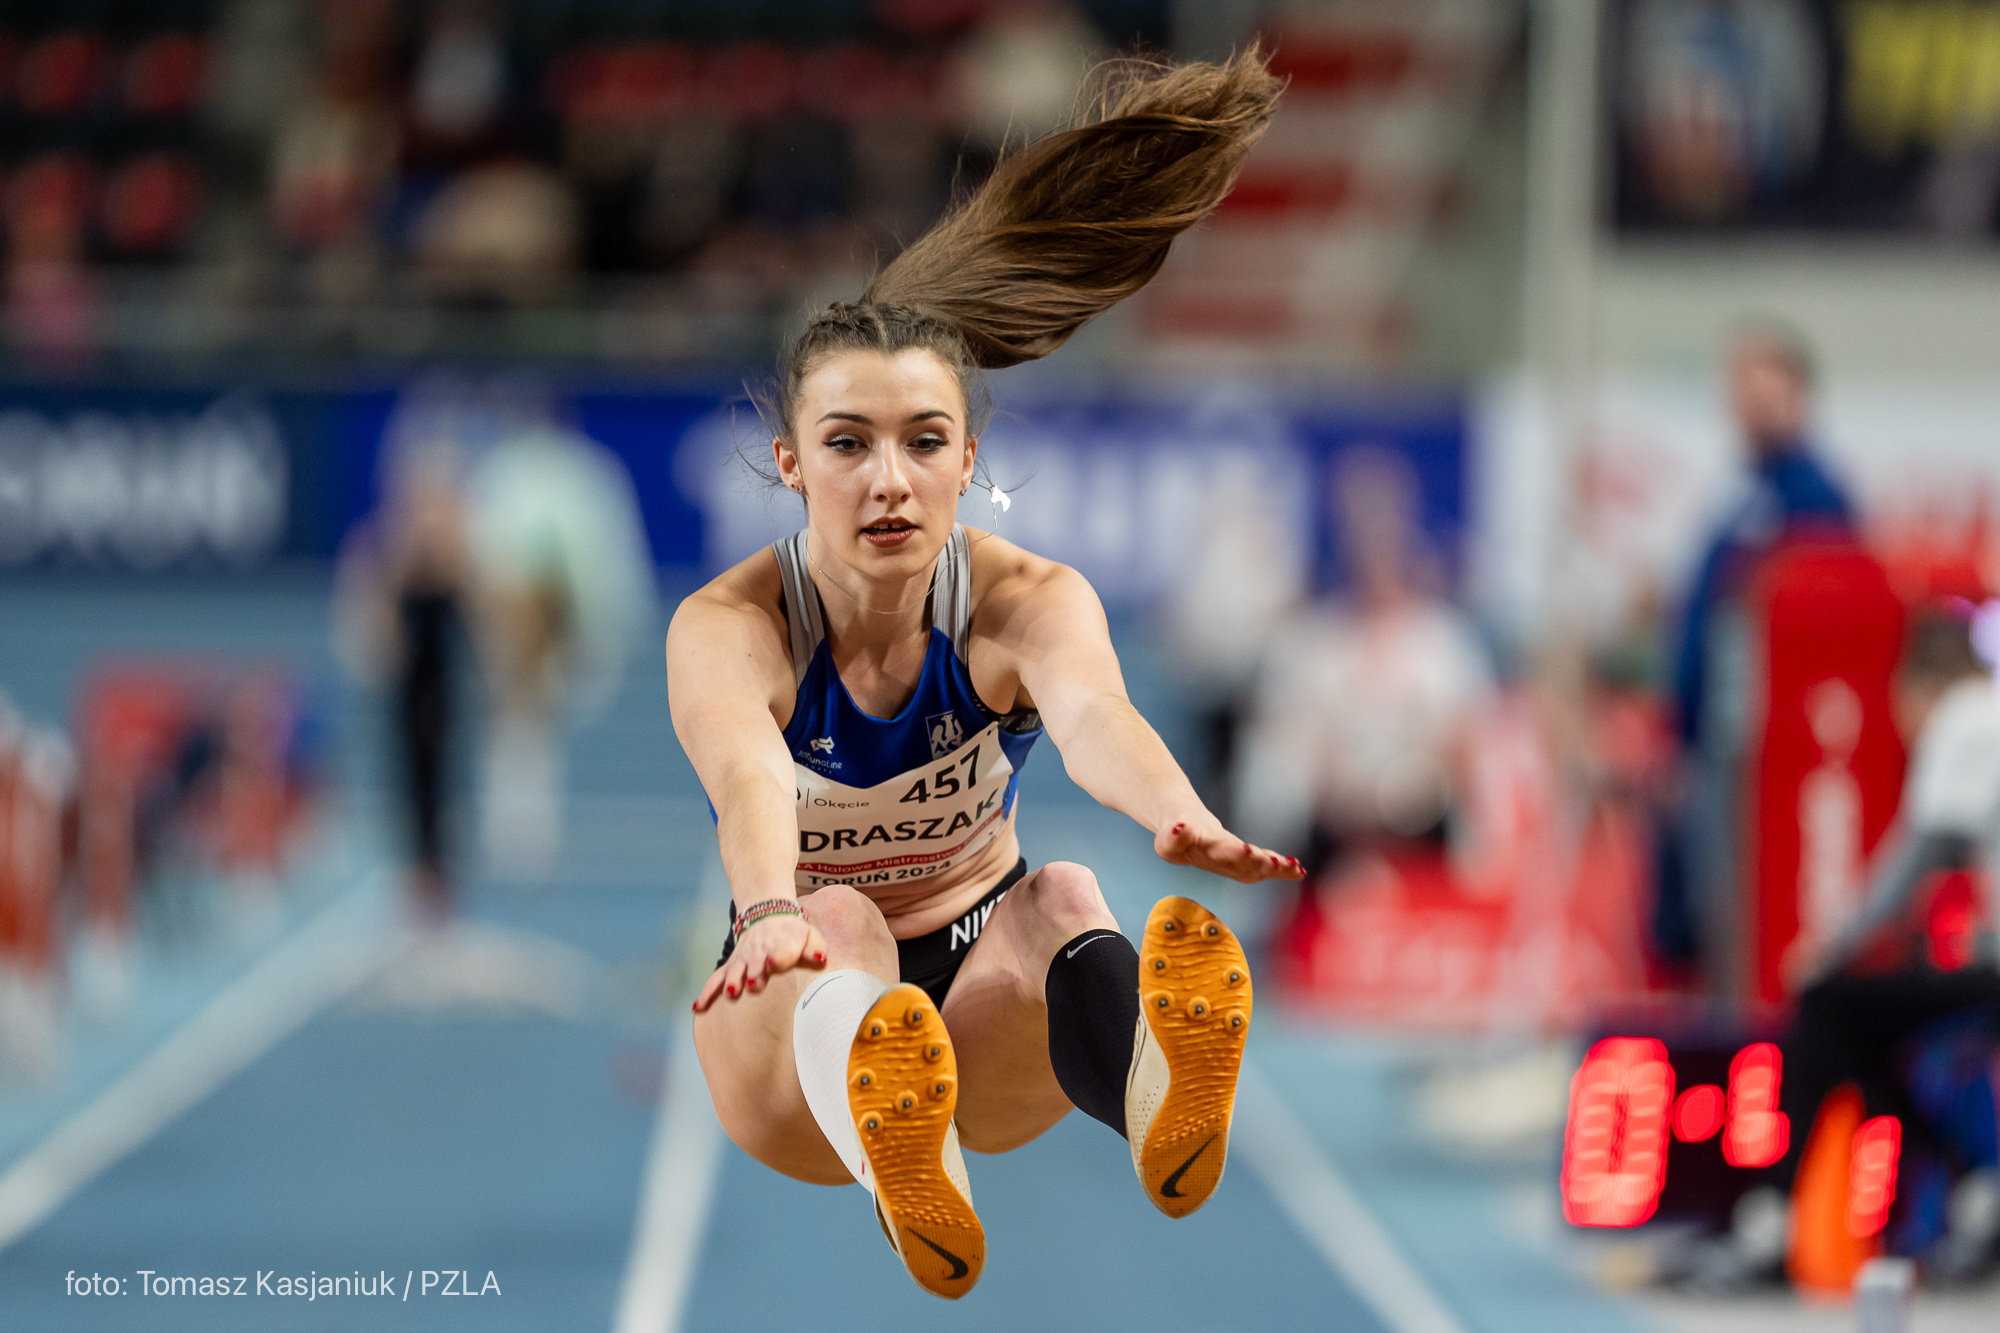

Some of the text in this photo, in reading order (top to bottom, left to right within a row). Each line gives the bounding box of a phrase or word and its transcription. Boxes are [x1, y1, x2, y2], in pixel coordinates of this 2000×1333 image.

[899, 743, 981, 804] 457
[800, 786, 999, 853] DRASZAK
[813, 797, 870, 809] Okęcie
[797, 862, 814, 870] LA
[817, 862, 872, 873] Halowe
[807, 860, 951, 886] TORUŃ 2024
[950, 889, 1008, 952] NIK
